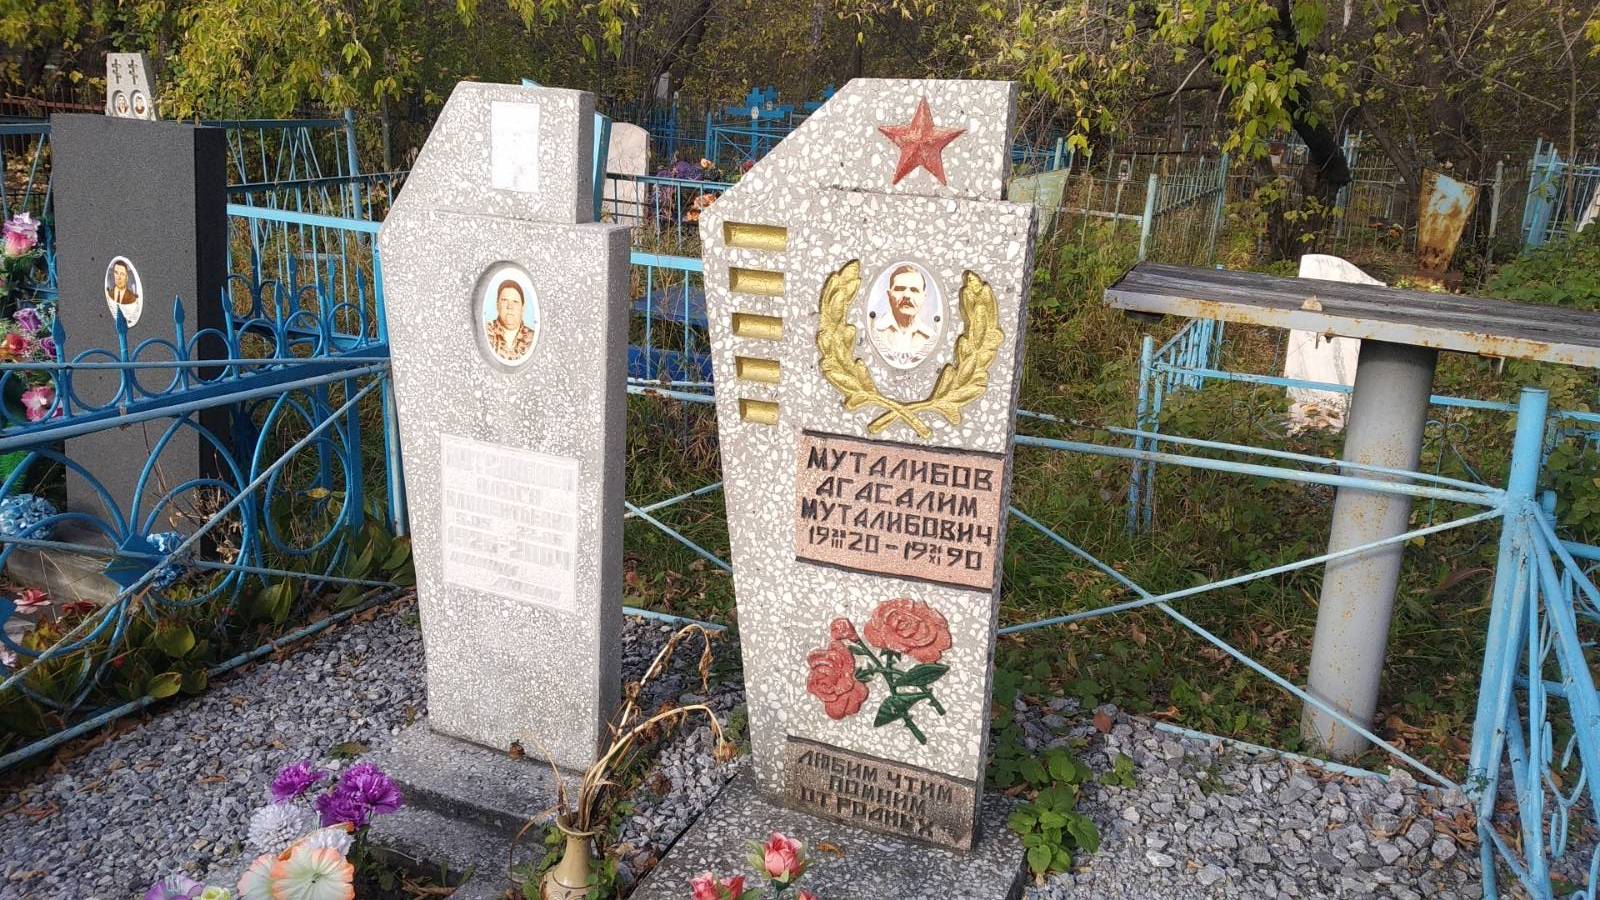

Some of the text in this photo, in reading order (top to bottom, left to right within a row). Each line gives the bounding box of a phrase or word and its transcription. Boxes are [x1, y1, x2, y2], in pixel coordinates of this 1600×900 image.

[807, 446, 994, 492] МУТАЛИБОВ
[815, 476, 978, 518] АГАСАЛИМ
[801, 497, 993, 546] МУТАЛИБОВИЧ
[829, 774, 927, 816] ПОМНИМ
[887, 771, 953, 803] ЧТИМ
